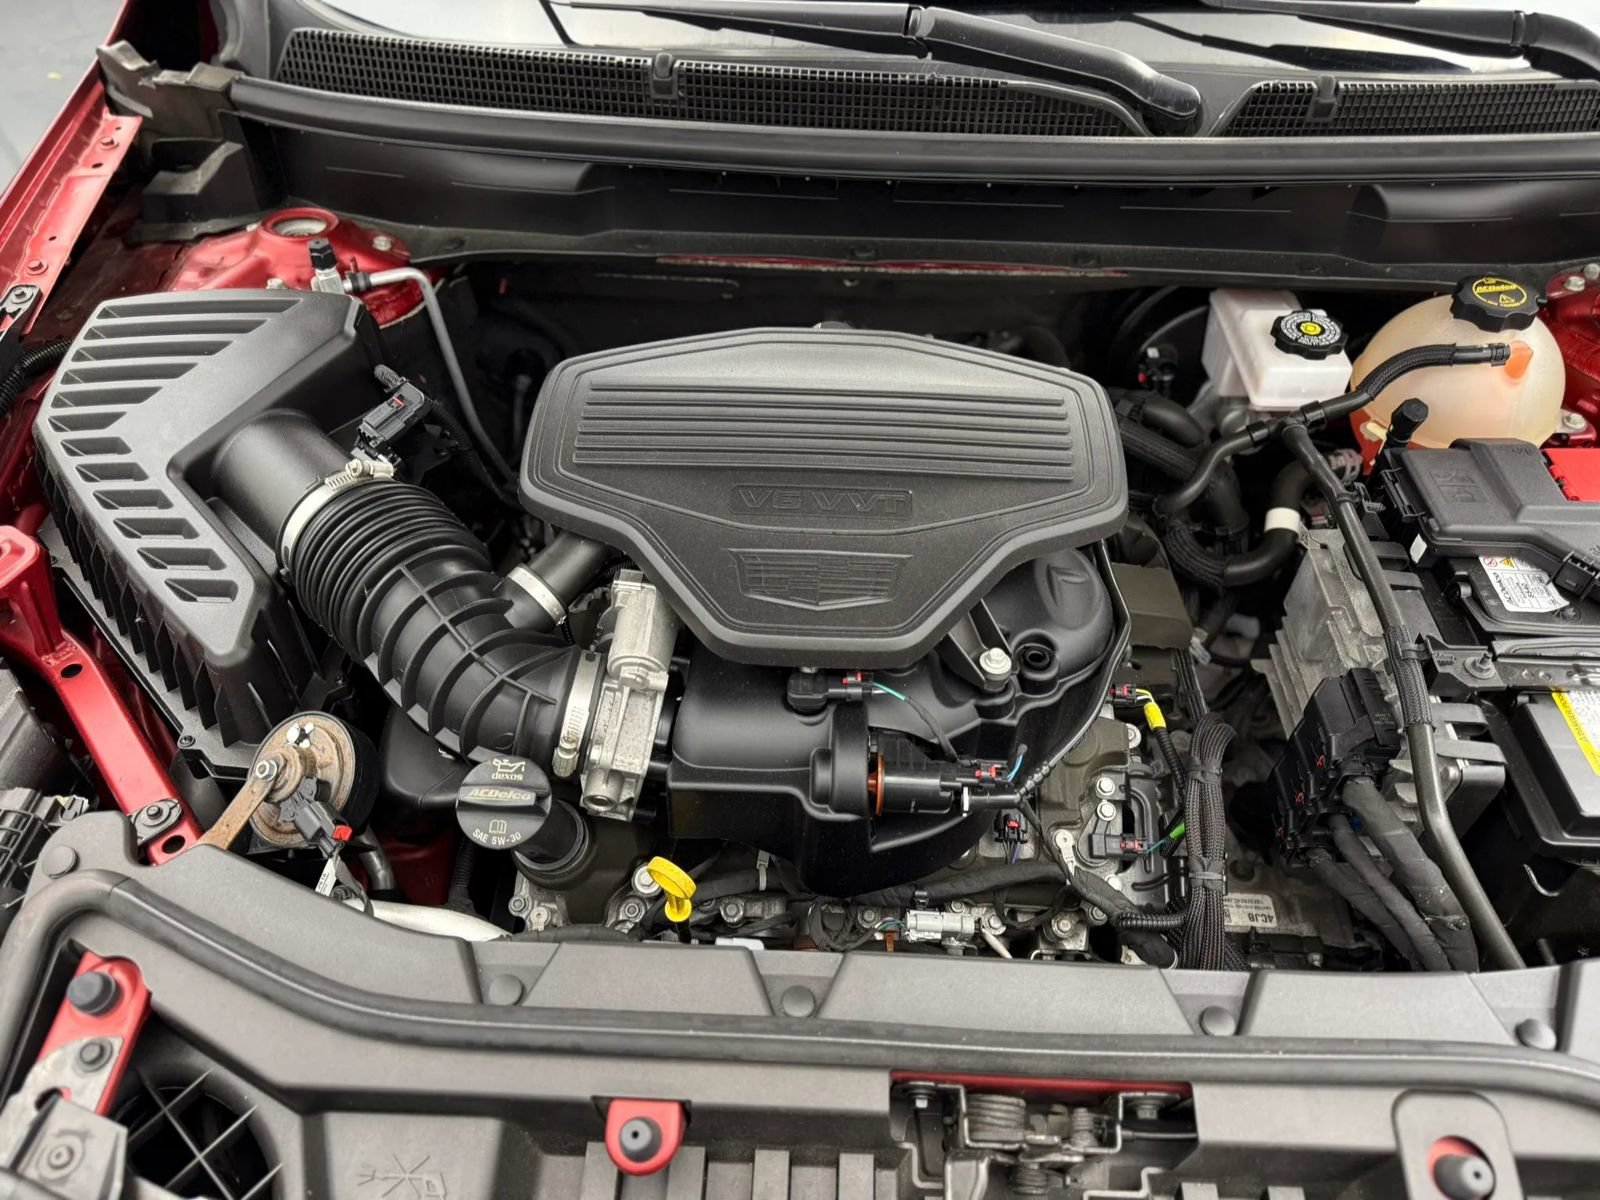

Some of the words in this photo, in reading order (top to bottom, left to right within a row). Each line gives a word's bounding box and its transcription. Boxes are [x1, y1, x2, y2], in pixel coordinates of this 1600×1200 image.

[1476, 284, 1517, 293] ACDelco
[737, 487, 801, 511] V6
[810, 490, 907, 514] VVT
[491, 772, 524, 781] dexos
[466, 787, 532, 801] ACDelco
[473, 828, 489, 844] SAE
[491, 831, 522, 846] 5W-30
[1247, 912, 1275, 923] 4CJB
